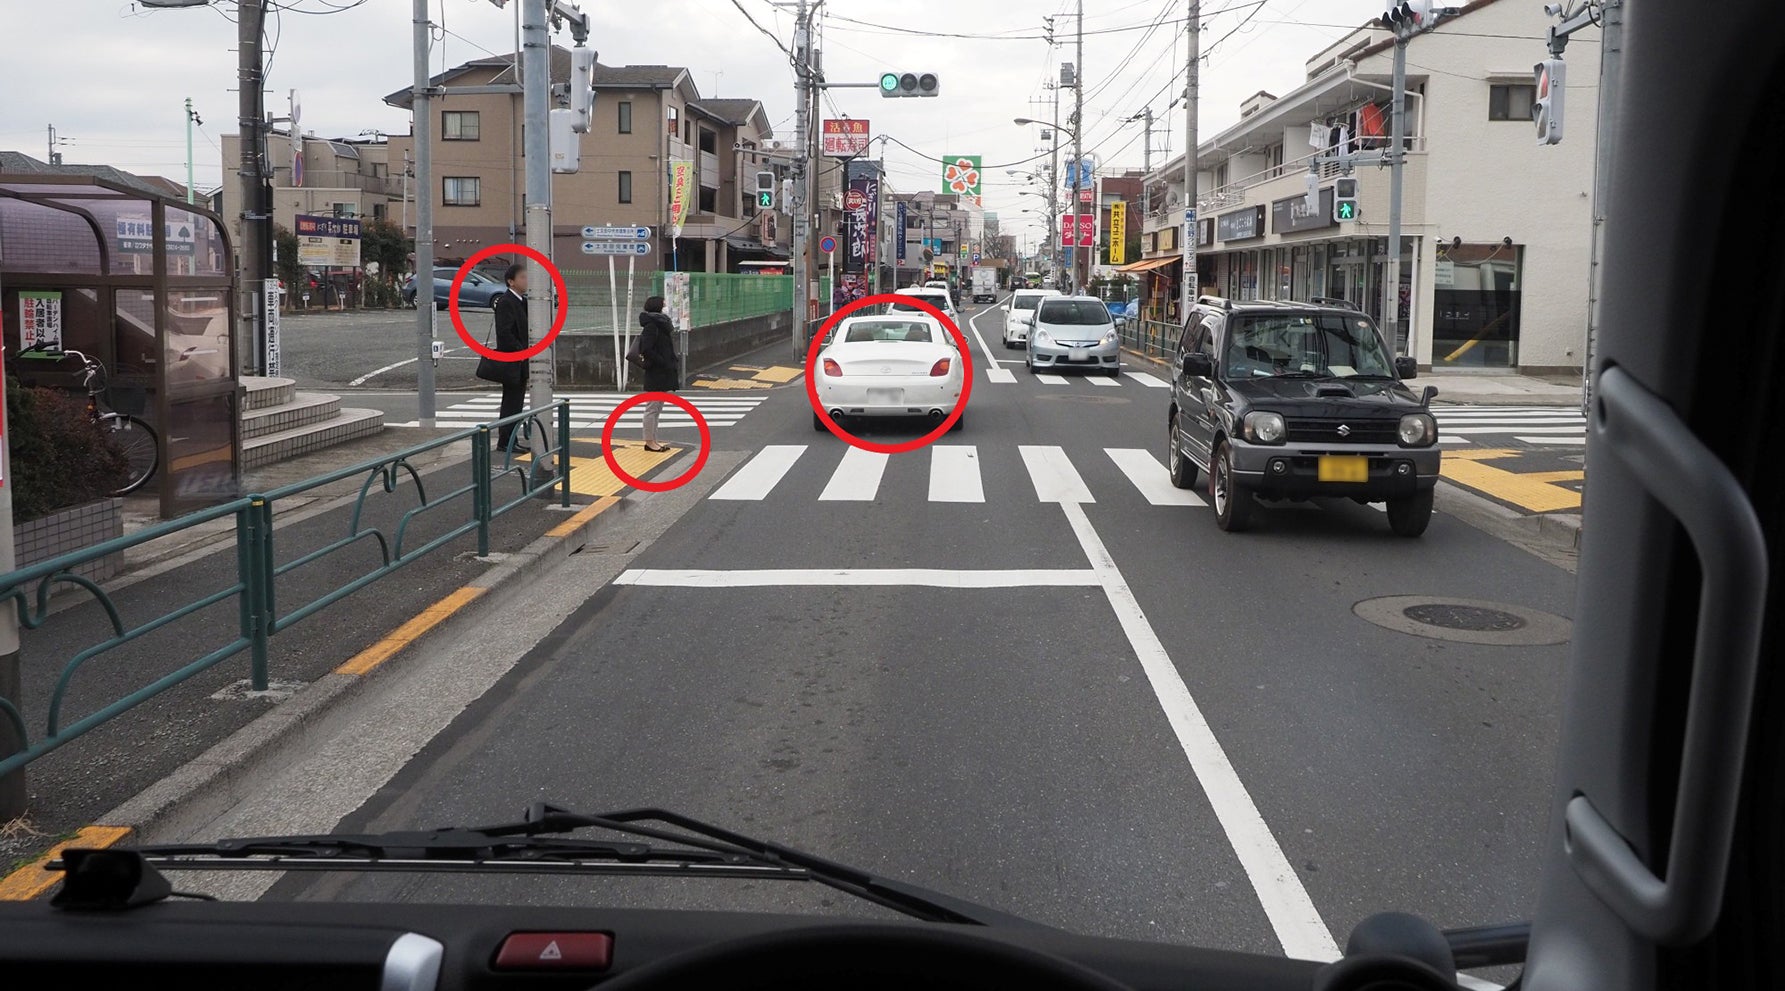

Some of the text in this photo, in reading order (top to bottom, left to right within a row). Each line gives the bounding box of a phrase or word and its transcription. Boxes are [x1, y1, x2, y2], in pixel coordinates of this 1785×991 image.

[865, 181, 877, 219] にぎり
[1063, 222, 1092, 230] DASO
